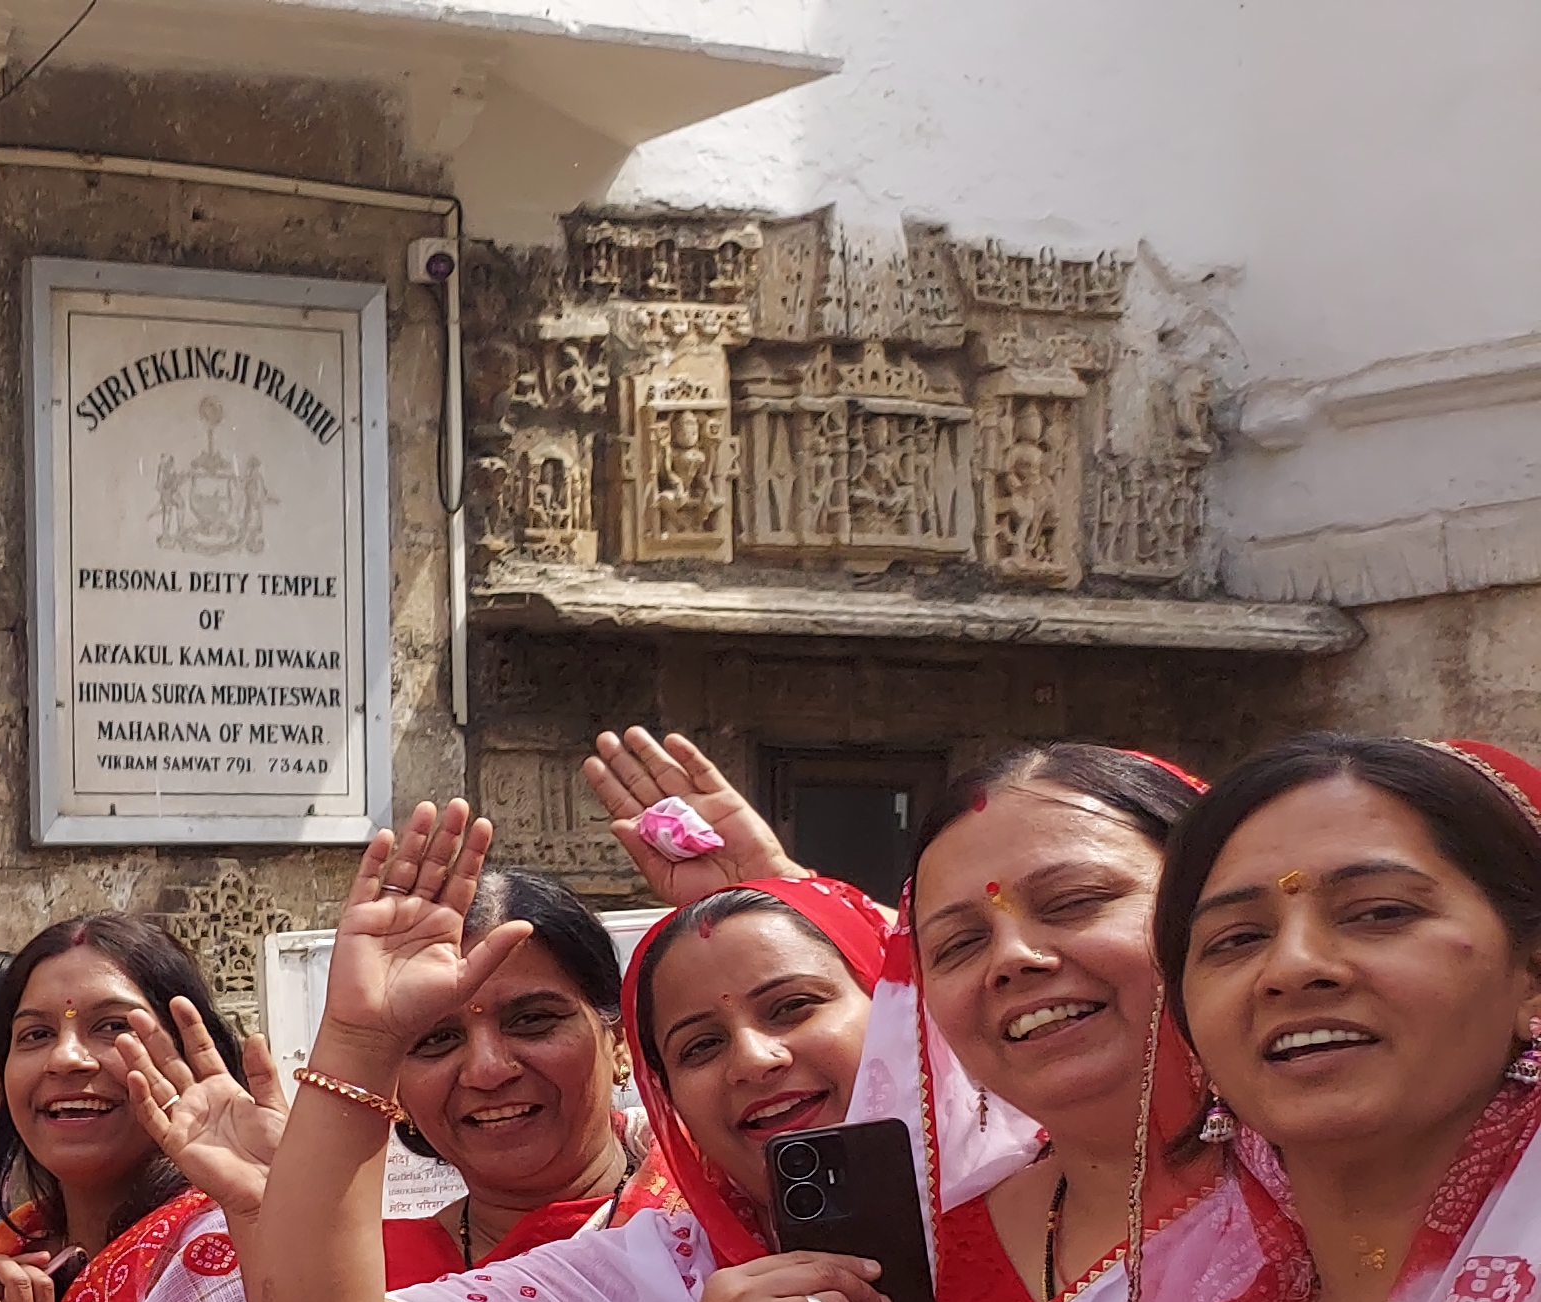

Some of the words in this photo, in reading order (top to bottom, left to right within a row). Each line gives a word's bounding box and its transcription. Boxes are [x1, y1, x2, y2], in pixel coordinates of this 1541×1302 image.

[76, 364, 138, 433] SHRI
[134, 345, 251, 391] EKLINGJI
[251, 358, 342, 445] PRABHU
[78, 568, 183, 592] PERSONAL
[188, 571, 250, 595] DEITY
[257, 573, 338, 598] TEMPLE
[198, 609, 226, 631] OF
[78, 644, 174, 667] ARYAKUL
[179, 646, 250, 669] KAMAL
[255, 648, 342, 671] DIWAKAR
[78, 681, 147, 705] HINDUA
[152, 683, 207, 706] SURYA
[211, 684, 342, 709] MEDPATESWAR
[97, 720, 212, 744] MAHARANA
[219, 722, 244, 744] OF
[97, 754, 158, 772] VIKRAM
[163, 756, 221, 773] SAMVAT
